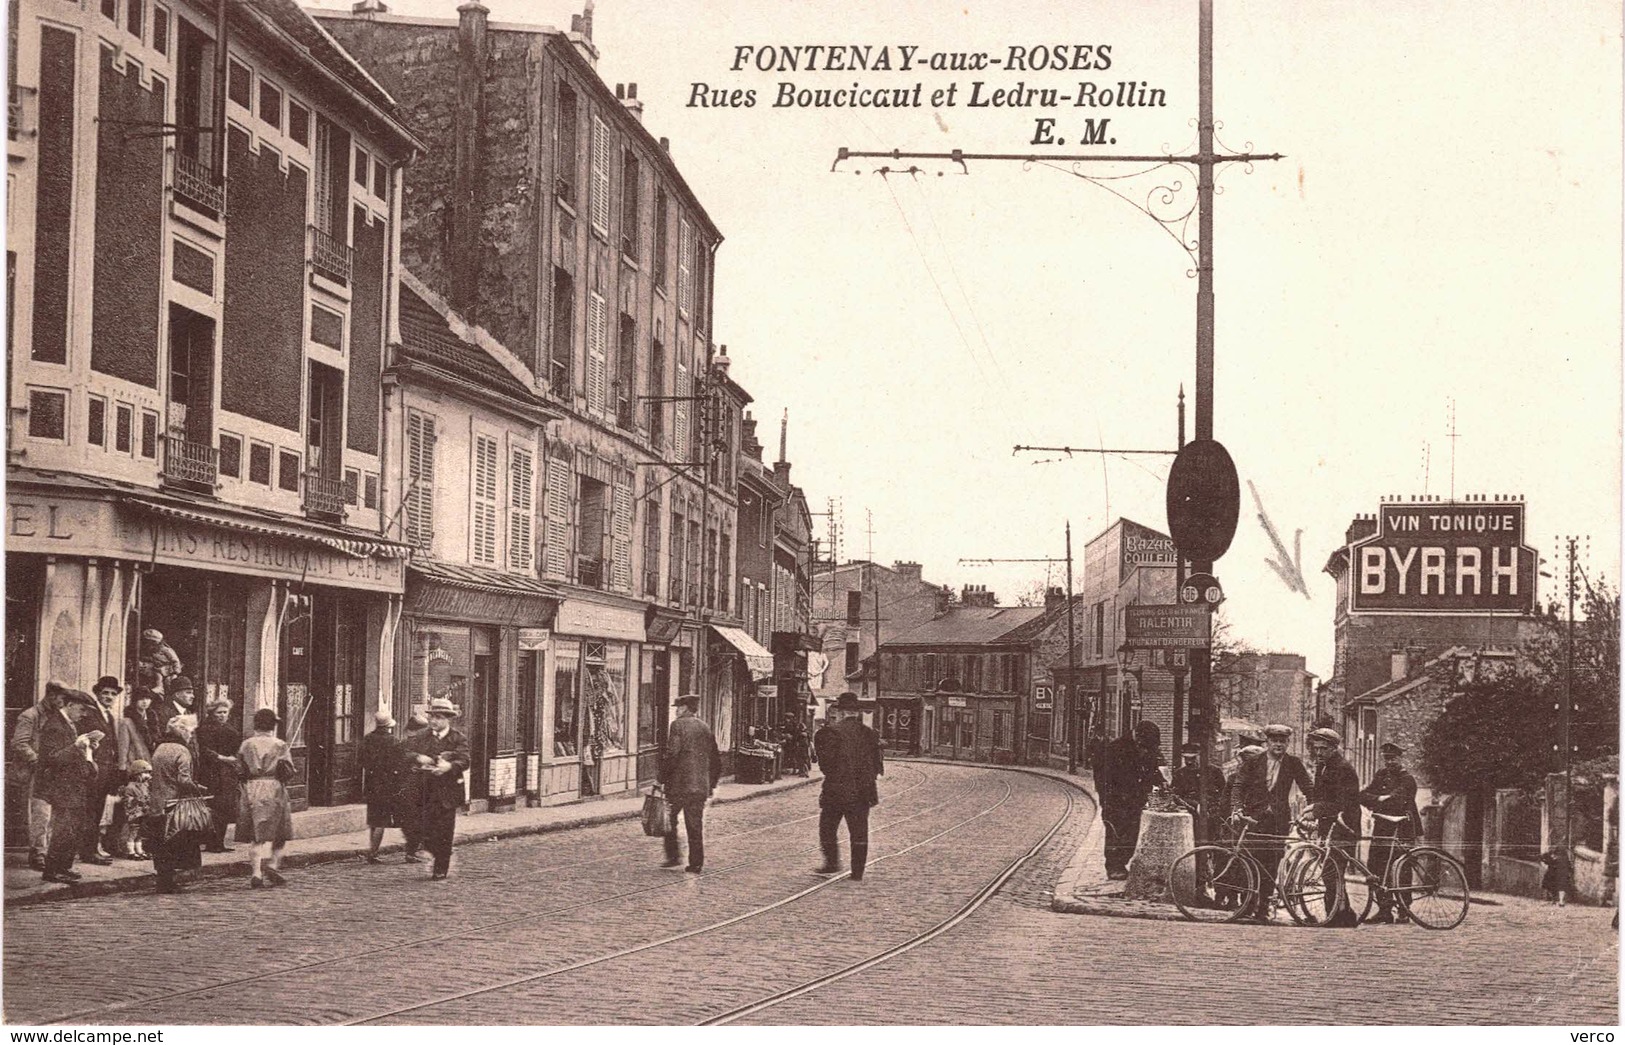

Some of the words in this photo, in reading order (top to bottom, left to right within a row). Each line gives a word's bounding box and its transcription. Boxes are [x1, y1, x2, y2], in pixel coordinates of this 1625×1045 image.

[1388, 515, 1420, 531] VIN
[1429, 514, 1514, 533] TONIQUE
[1360, 546, 1518, 595] BYRRH
[1140, 617, 1192, 628] RALENTIR
